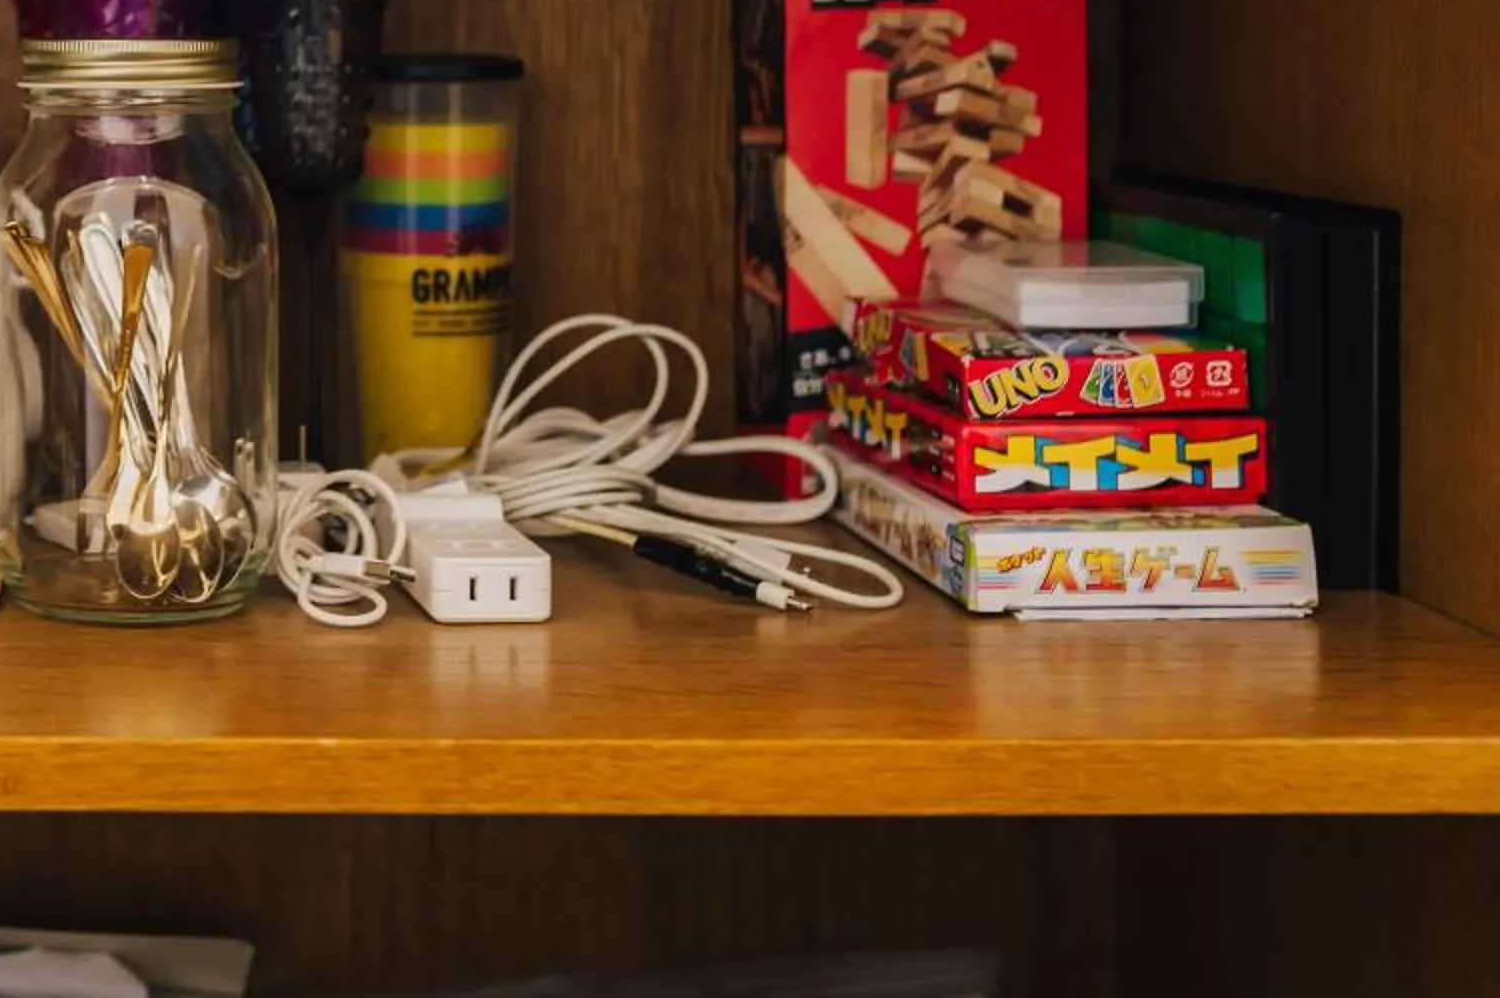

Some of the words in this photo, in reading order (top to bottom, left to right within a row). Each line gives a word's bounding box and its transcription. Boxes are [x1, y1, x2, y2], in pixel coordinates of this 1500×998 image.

[969, 354, 1070, 418] UNO
[1035, 546, 1243, 595] 人生ゲーム
